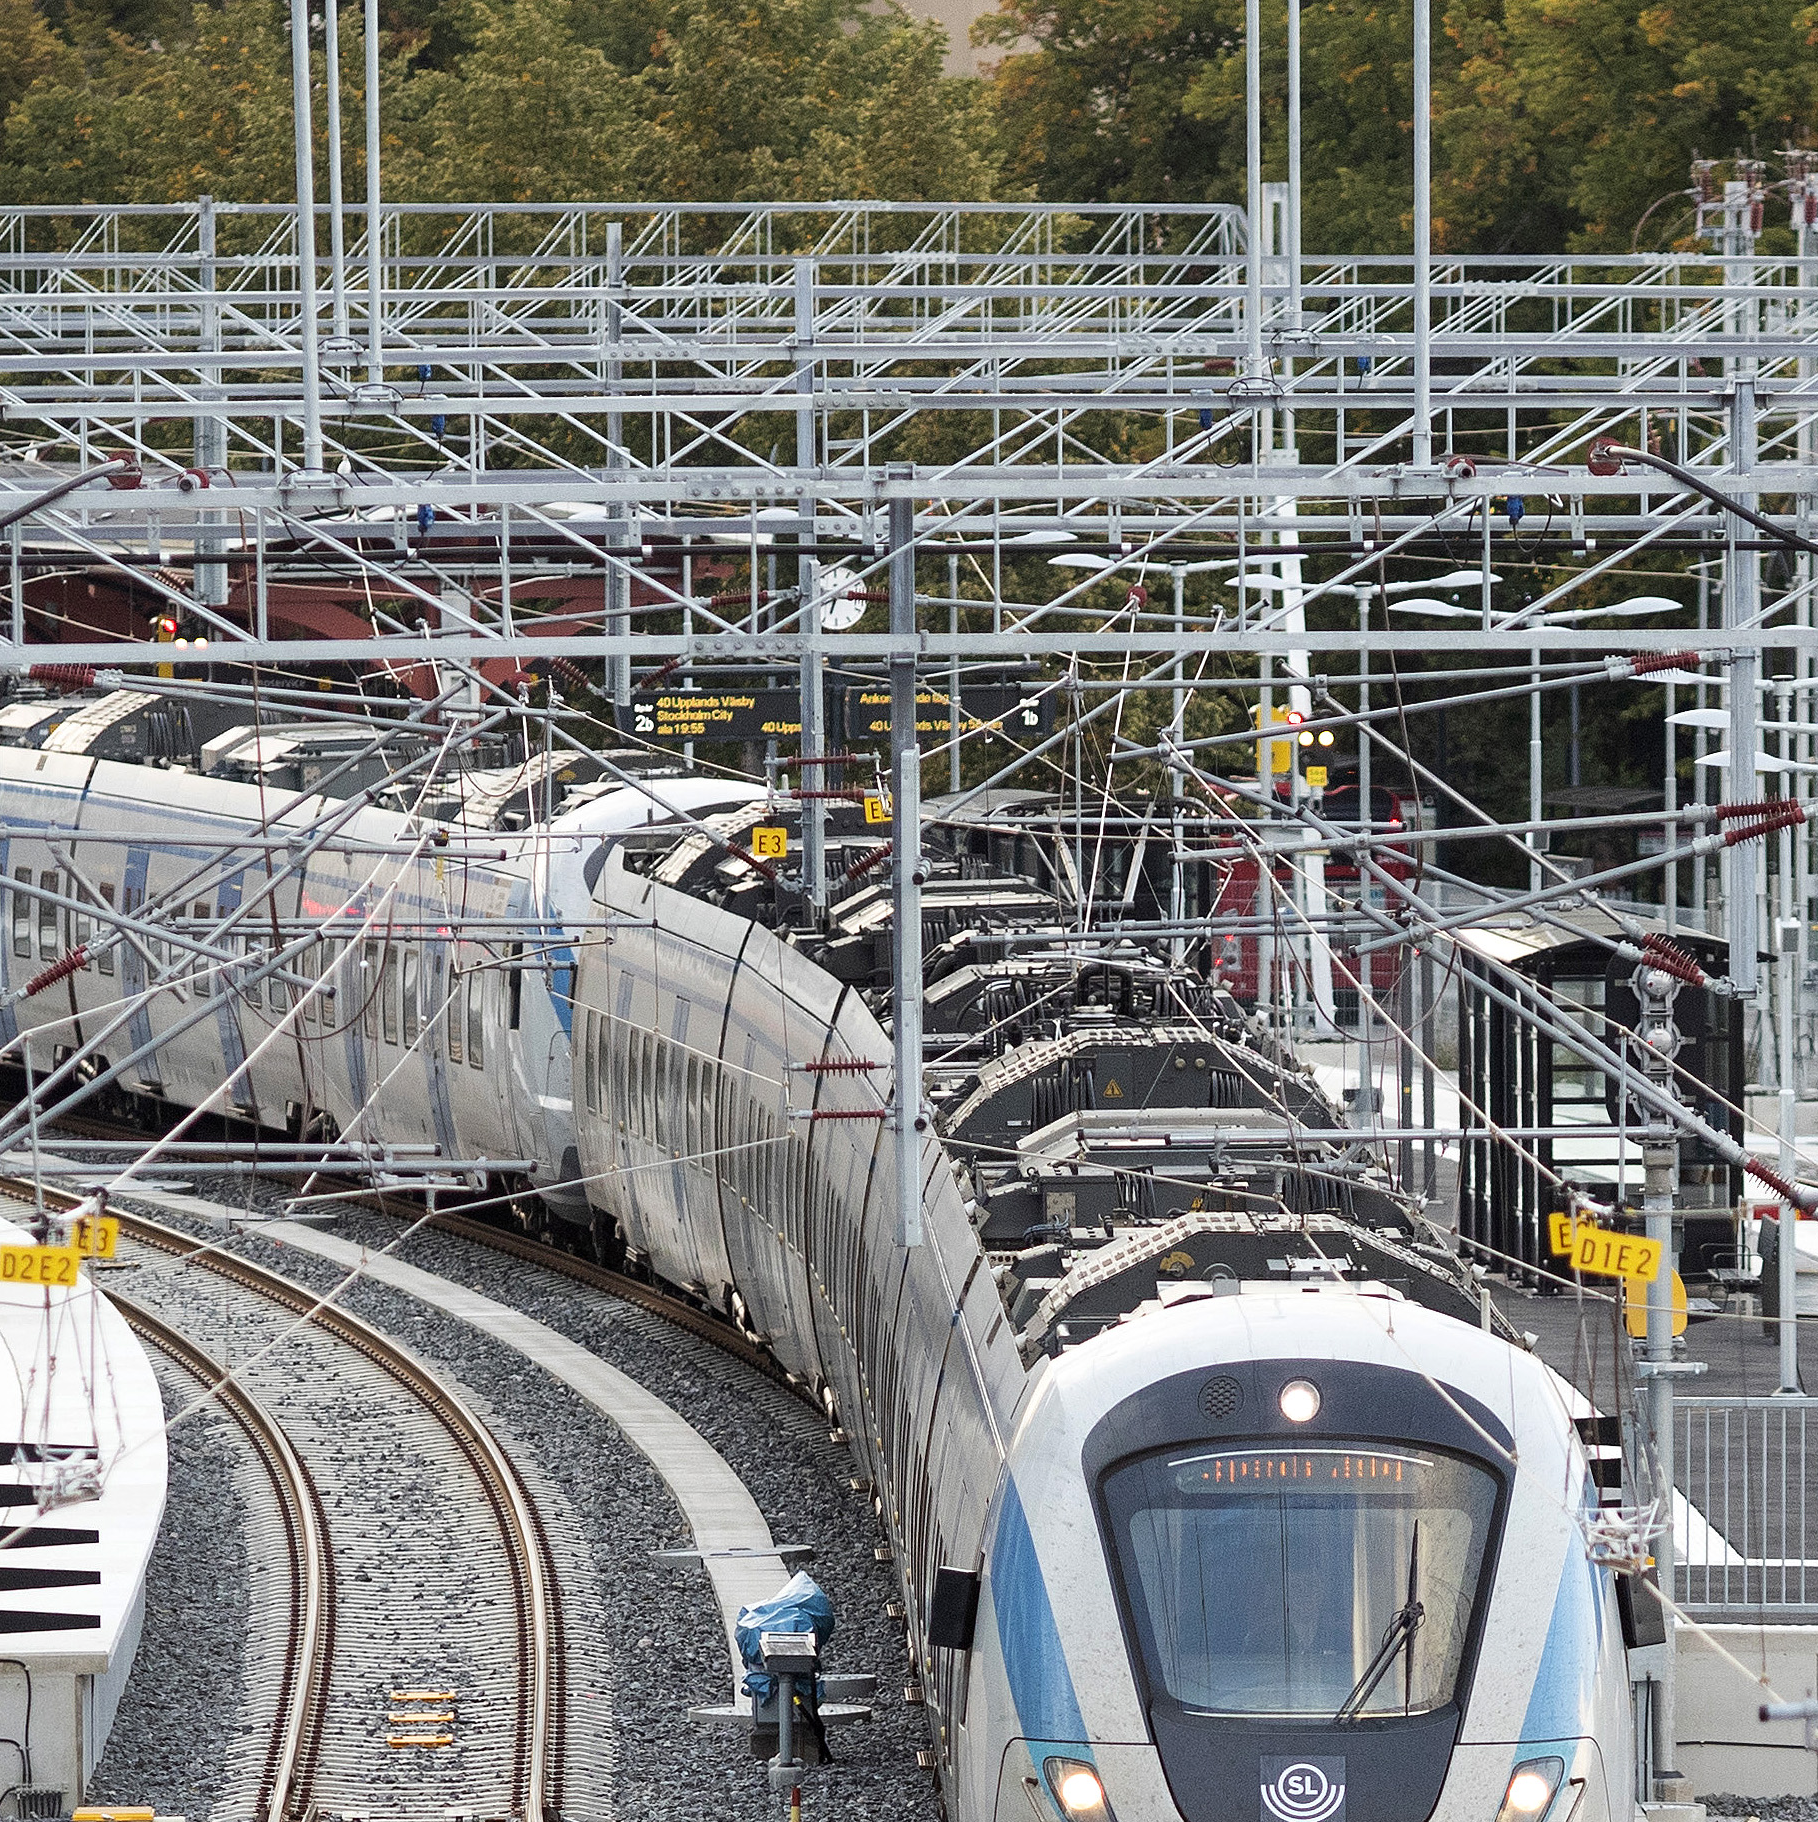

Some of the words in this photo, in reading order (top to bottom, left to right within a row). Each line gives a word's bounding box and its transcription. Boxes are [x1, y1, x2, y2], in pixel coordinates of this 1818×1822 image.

[656, 697, 671, 708] 40
[672, 696, 719, 709] Upplands
[634, 714, 654, 732] 2b
[656, 710, 711, 722] Stockholm
[712, 709, 733, 722] City
[1021, 709, 1039, 726] 1b
[757, 834, 782, 854] E3
[1580, 1238, 1653, 1276] D1E2
[2, 1253, 71, 1283] D2E2
[1287, 1775, 1319, 1796] SL
